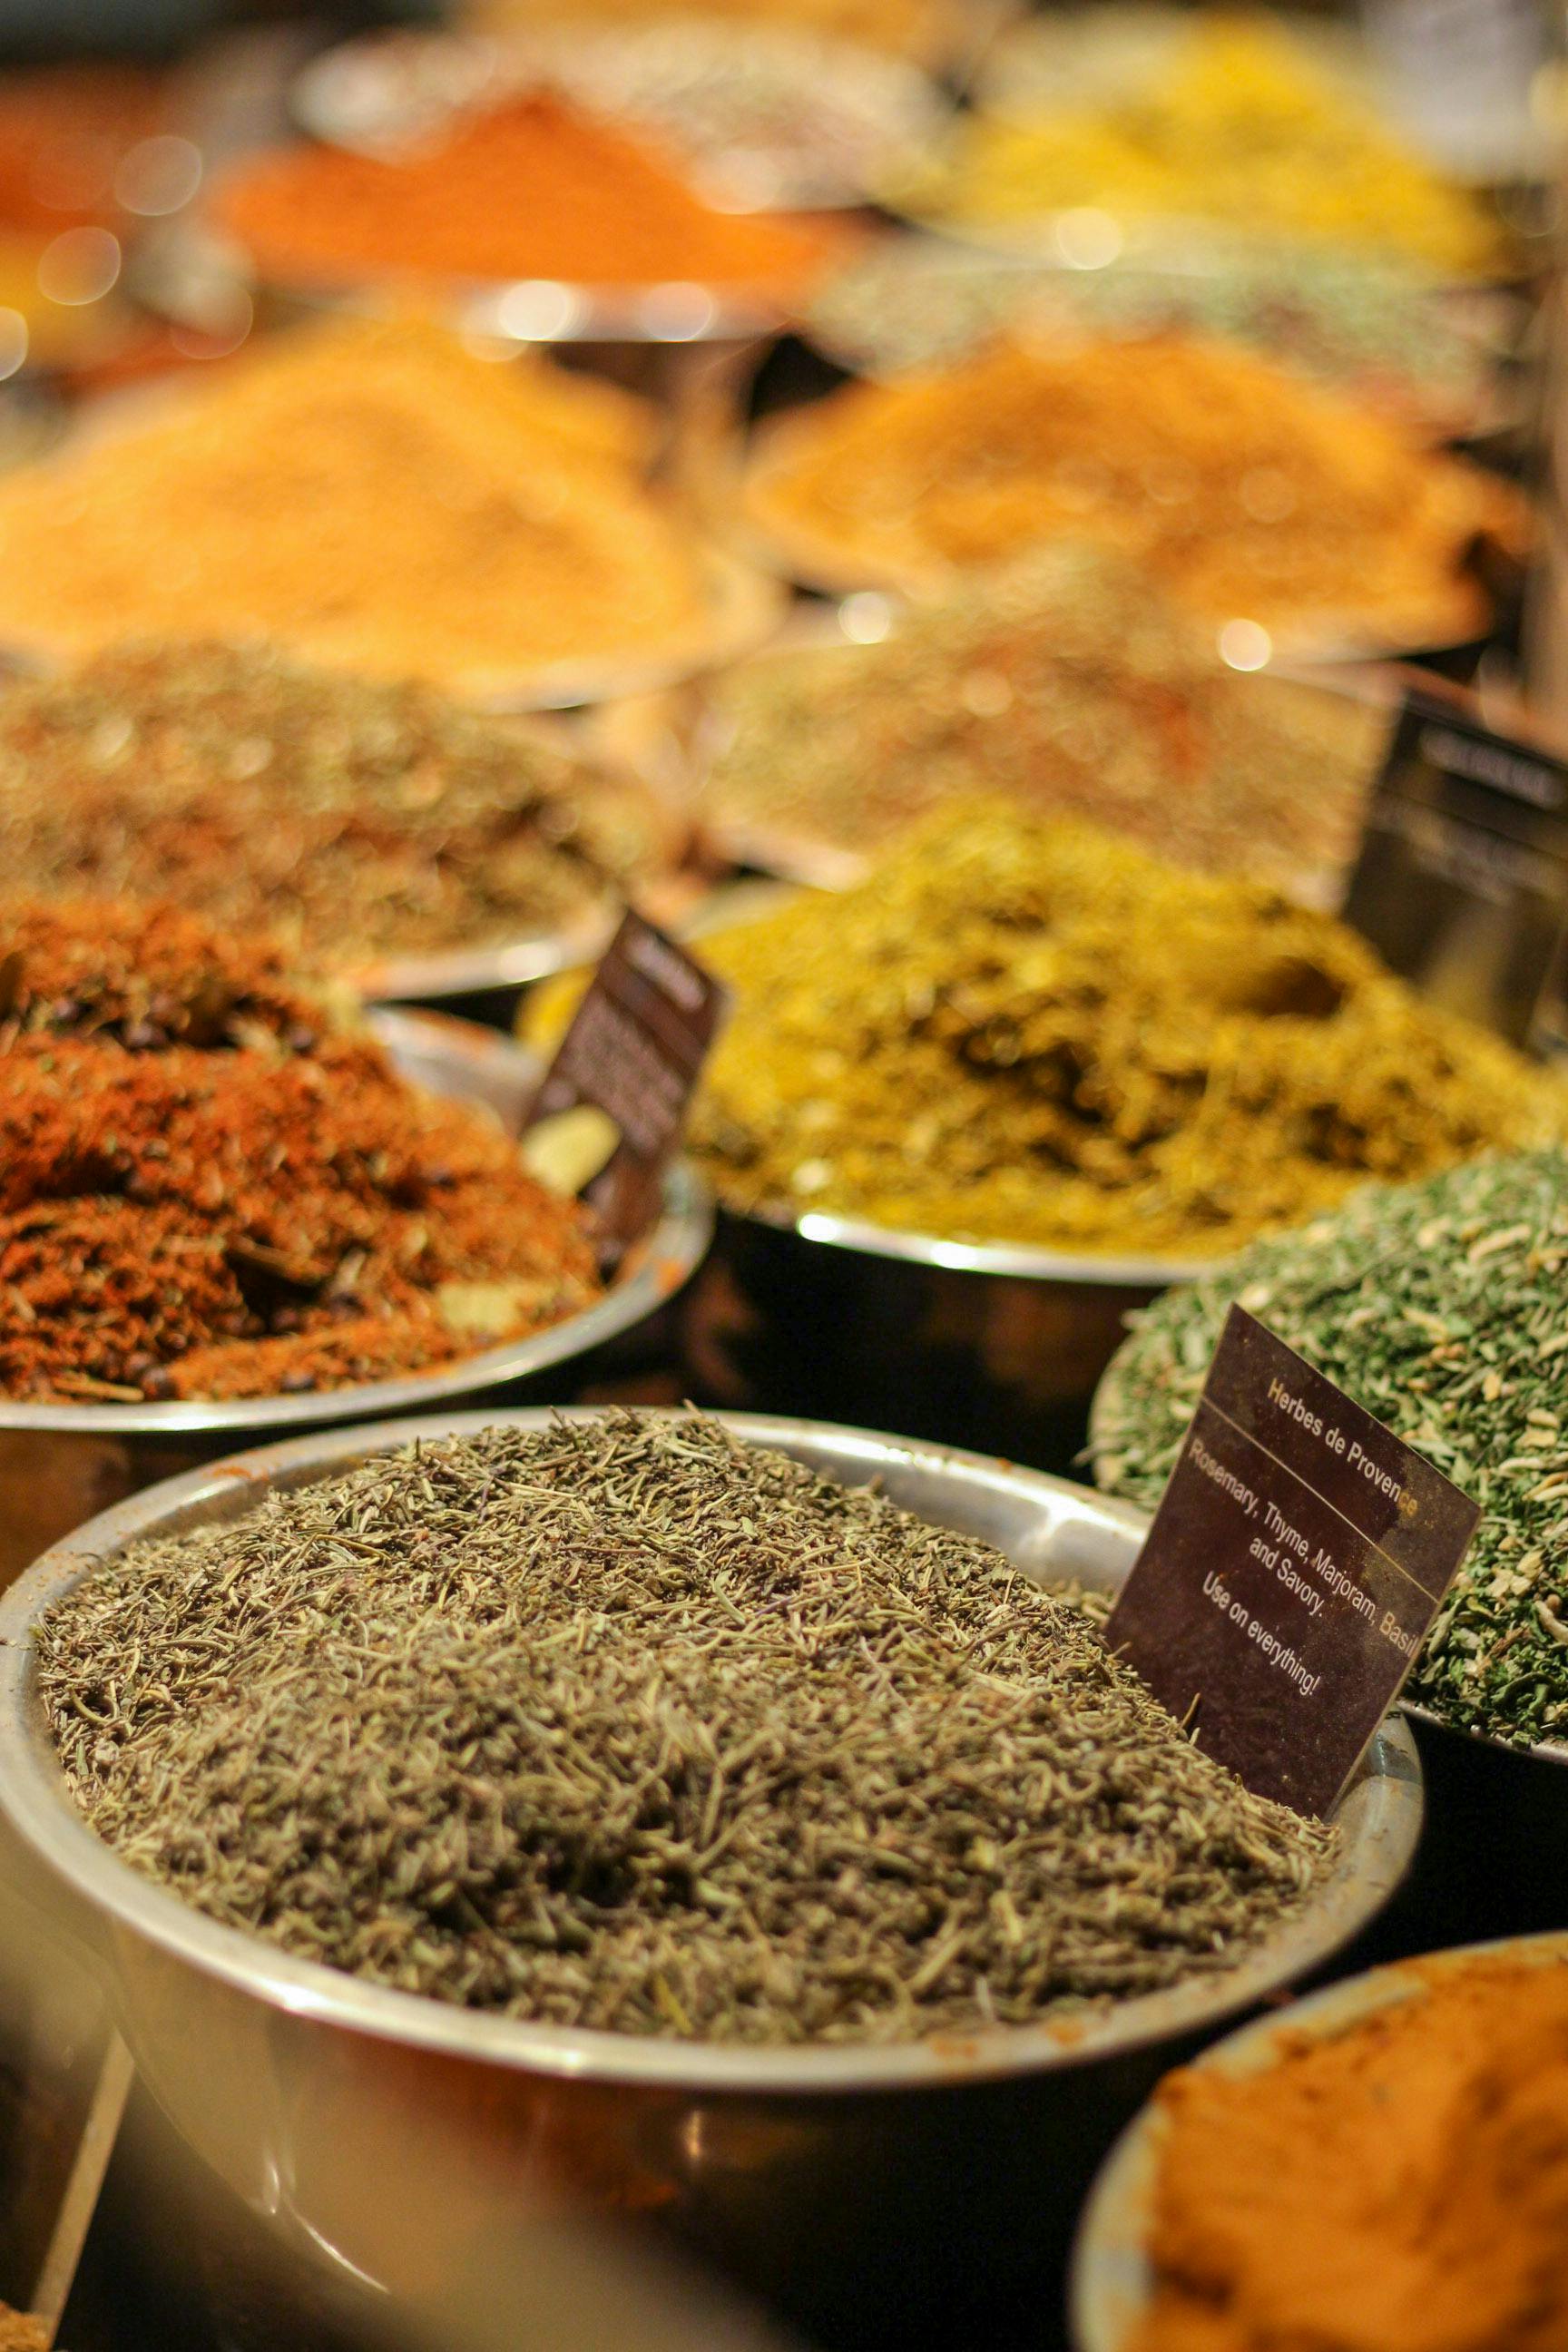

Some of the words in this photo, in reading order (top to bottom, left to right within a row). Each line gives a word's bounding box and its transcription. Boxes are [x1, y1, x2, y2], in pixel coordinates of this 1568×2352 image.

[1267, 1377, 1323, 1436] Herbes
[1325, 1427, 1346, 1454] de
[1189, 1438, 1259, 1518] Rosemary,
[1264, 1501, 1308, 1563] Thyme,
[1313, 1549, 1377, 1626] Marjoram,
[1249, 1537, 1279, 1569] and
[1277, 1558, 1325, 1617] Savory.
[1202, 1571, 1230, 1611] Use
[1229, 1602, 1249, 1629] on
[1248, 1621, 1321, 1696] everything!
